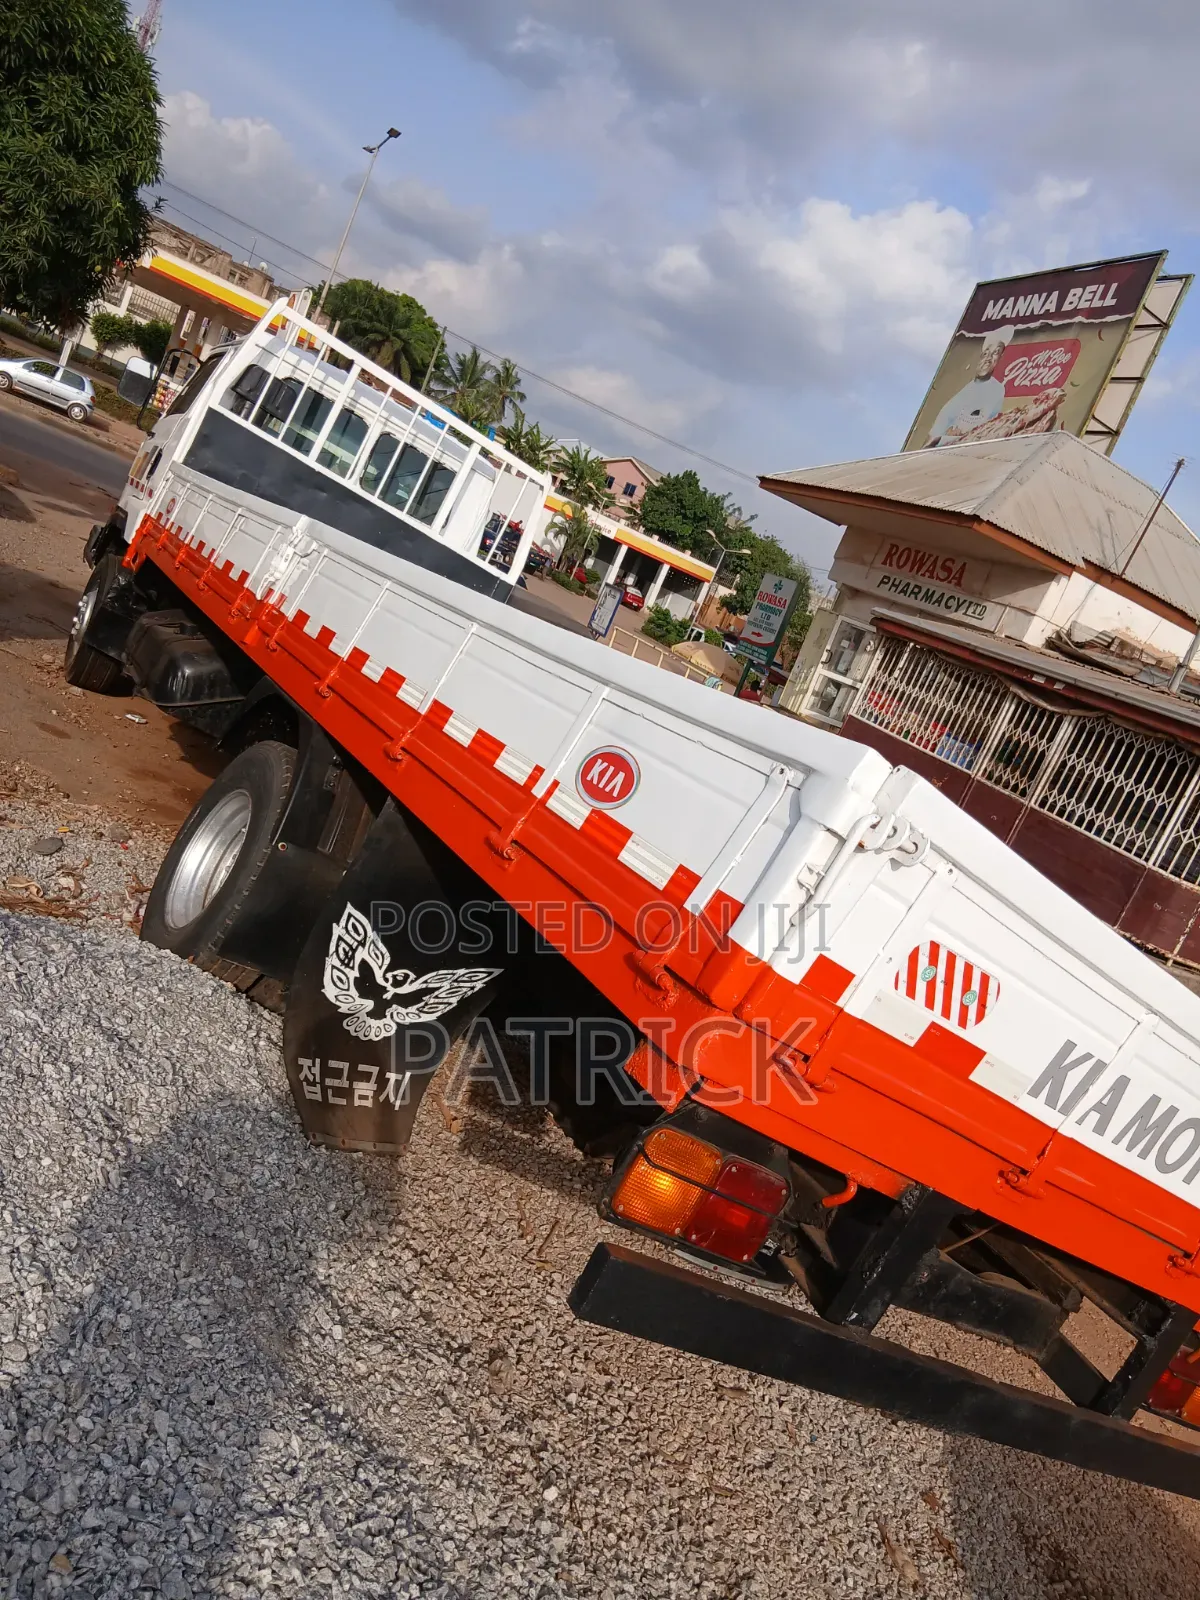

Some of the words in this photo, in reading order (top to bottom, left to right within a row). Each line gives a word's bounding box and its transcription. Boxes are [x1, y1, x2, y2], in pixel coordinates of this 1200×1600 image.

[981, 291, 1059, 321] MANNA
[1061, 283, 1118, 311] BELL
[881, 542, 968, 588] ROWASA
[755, 602, 784, 617] PHARMACY
[757, 590, 788, 609] ROWASA
[760, 612, 772, 621] LTD
[877, 574, 966, 613] PHARMACY
[962, 600, 988, 621] LTD
[586, 758, 626, 798] KIA
[297, 1057, 412, 1111] 접근금지
[1026, 1039, 1132, 1137] KIA
[1111, 1093, 1200, 1185] MO
